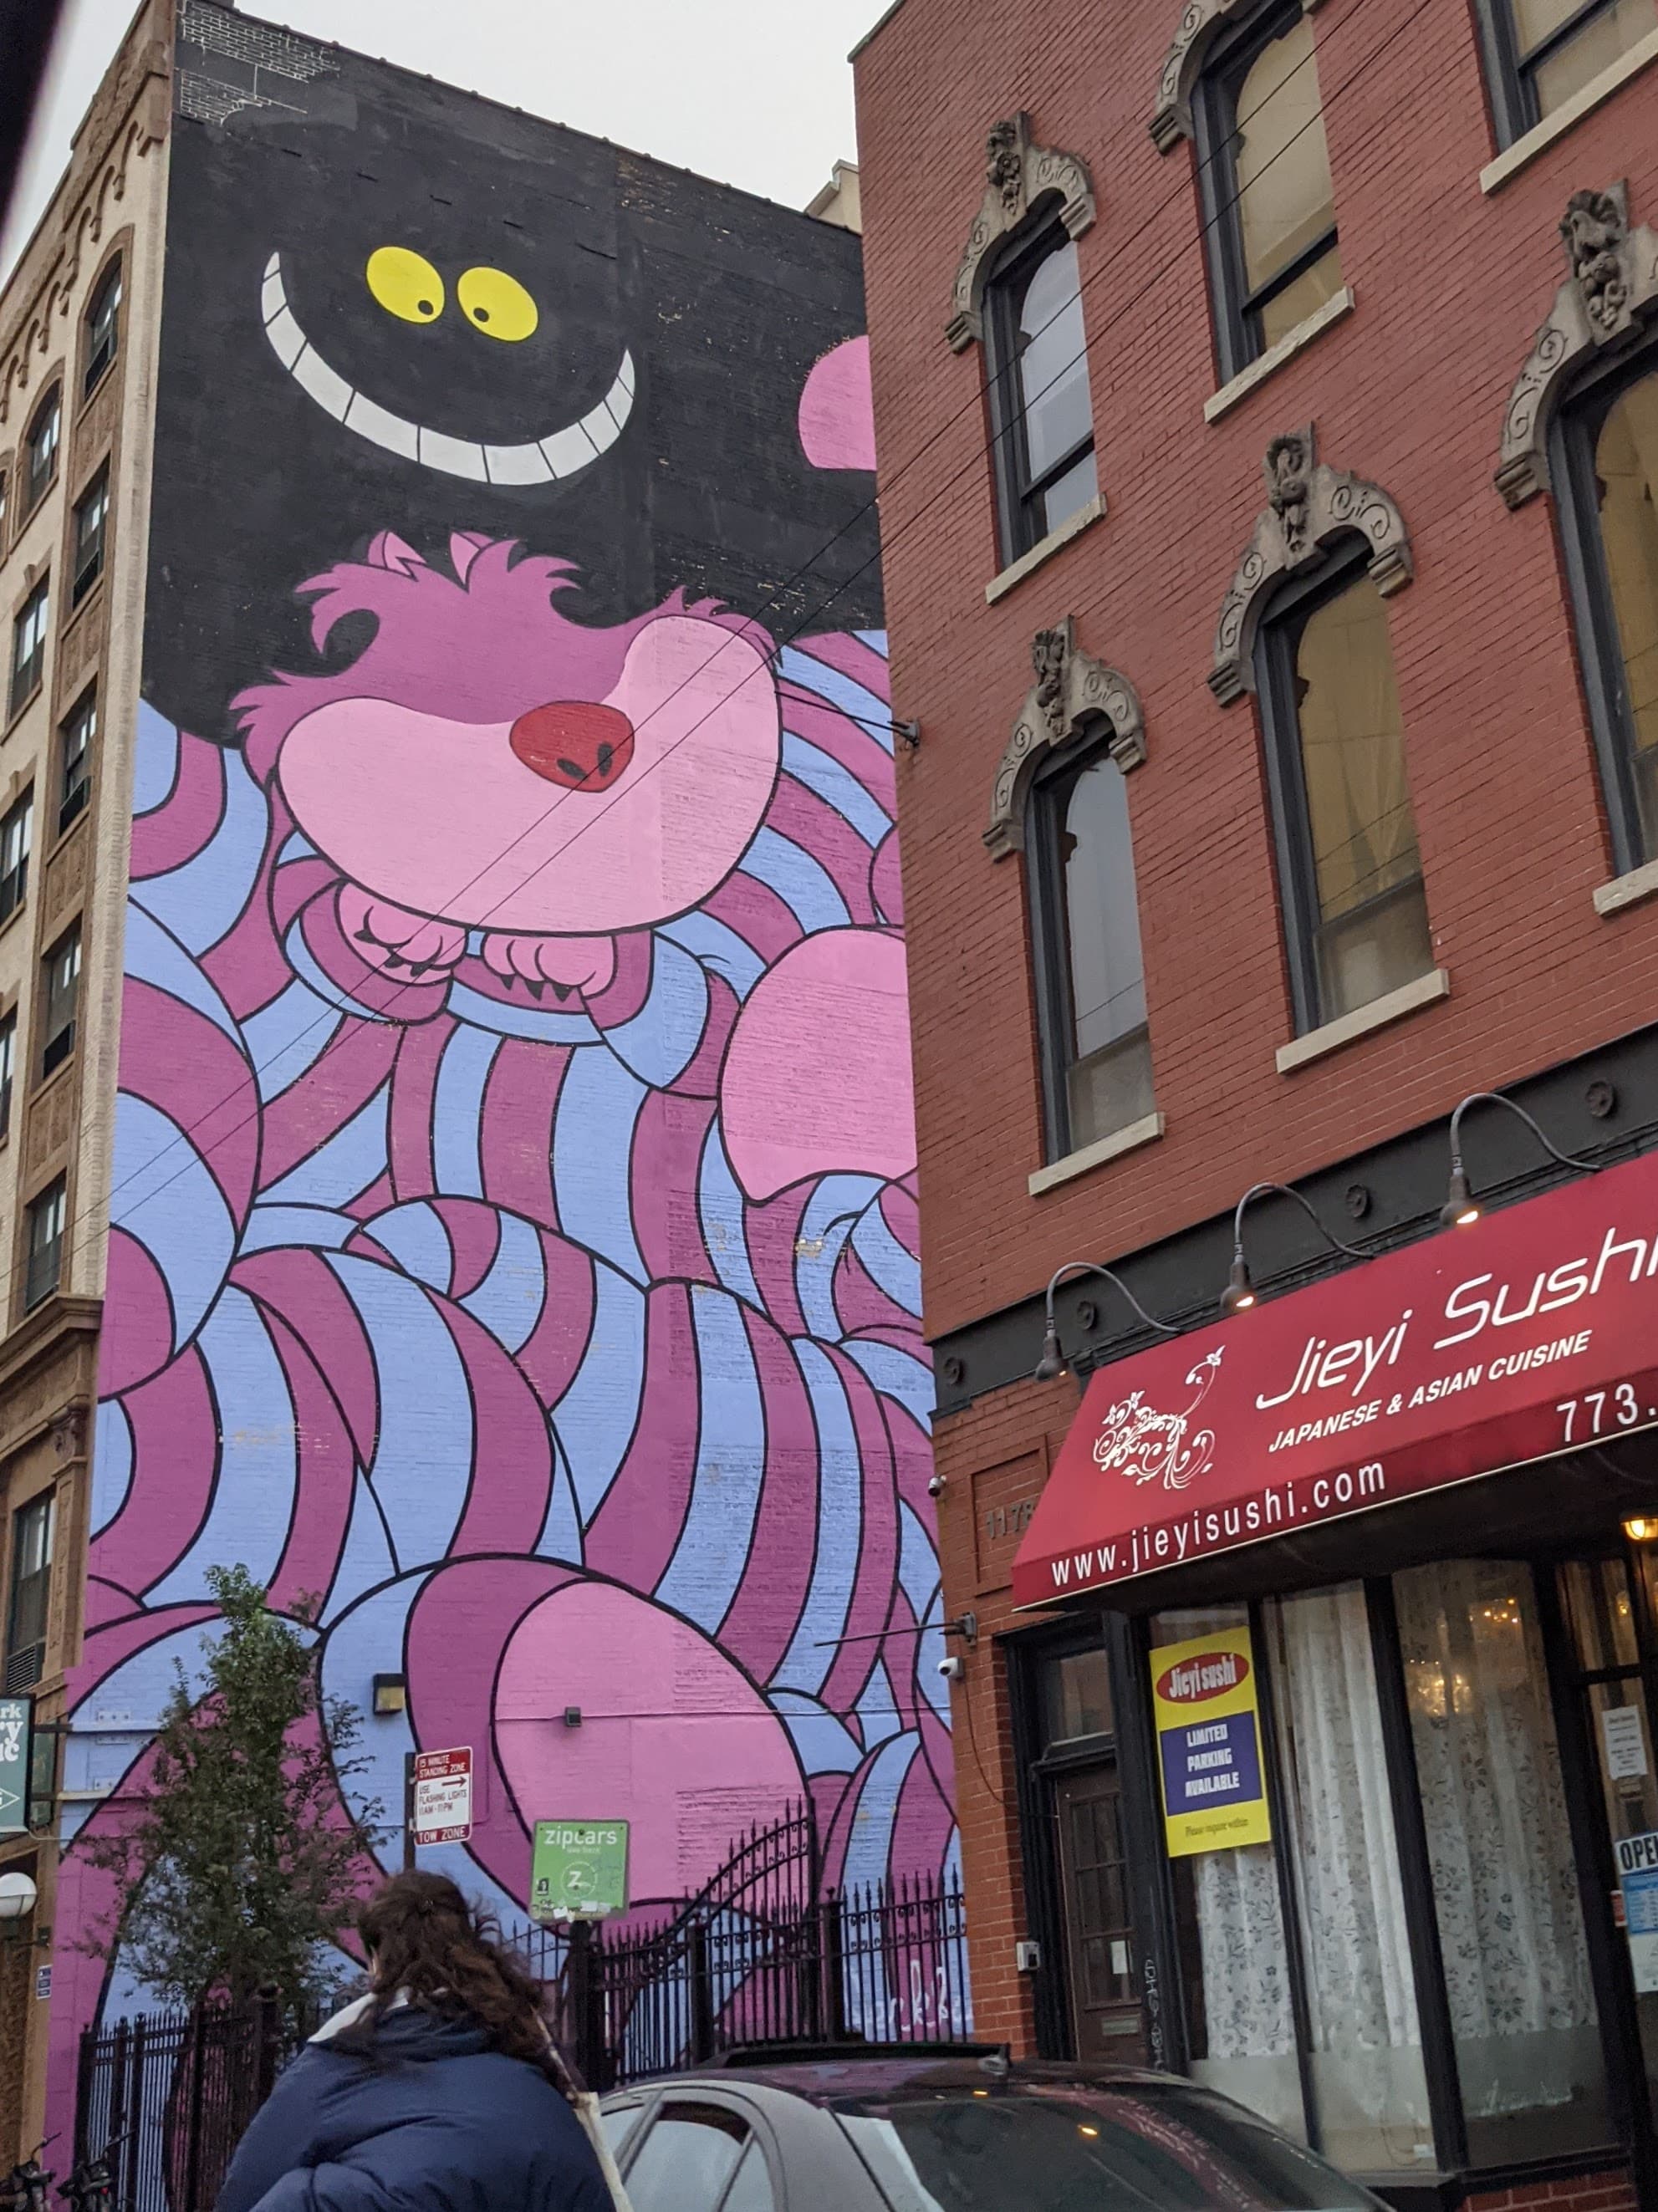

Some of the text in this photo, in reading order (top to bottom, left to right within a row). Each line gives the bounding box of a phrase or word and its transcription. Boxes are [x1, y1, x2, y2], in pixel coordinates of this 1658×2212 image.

[1256, 1308, 1413, 1409] Jieyi
[1268, 1329, 1593, 1453] JAPANESE & ASIAN CUISINE
[1051, 1461, 1385, 1588] www.jieyisushi.com
[1169, 1654, 1237, 1700] Jieyi sushi
[1186, 1724, 1228, 1747] LIMITED
[420, 1763, 466, 1778] STANDING ZONE
[1187, 1748, 1232, 1772] PARKING
[419, 1789, 467, 1805] FLASHING LIGHTS
[1185, 1772, 1240, 1798] AVAILABLE
[419, 1826, 466, 1842] TOW ZONE
[544, 1825, 617, 1849] zipcars
[1620, 1835, 1658, 1871] OPE
